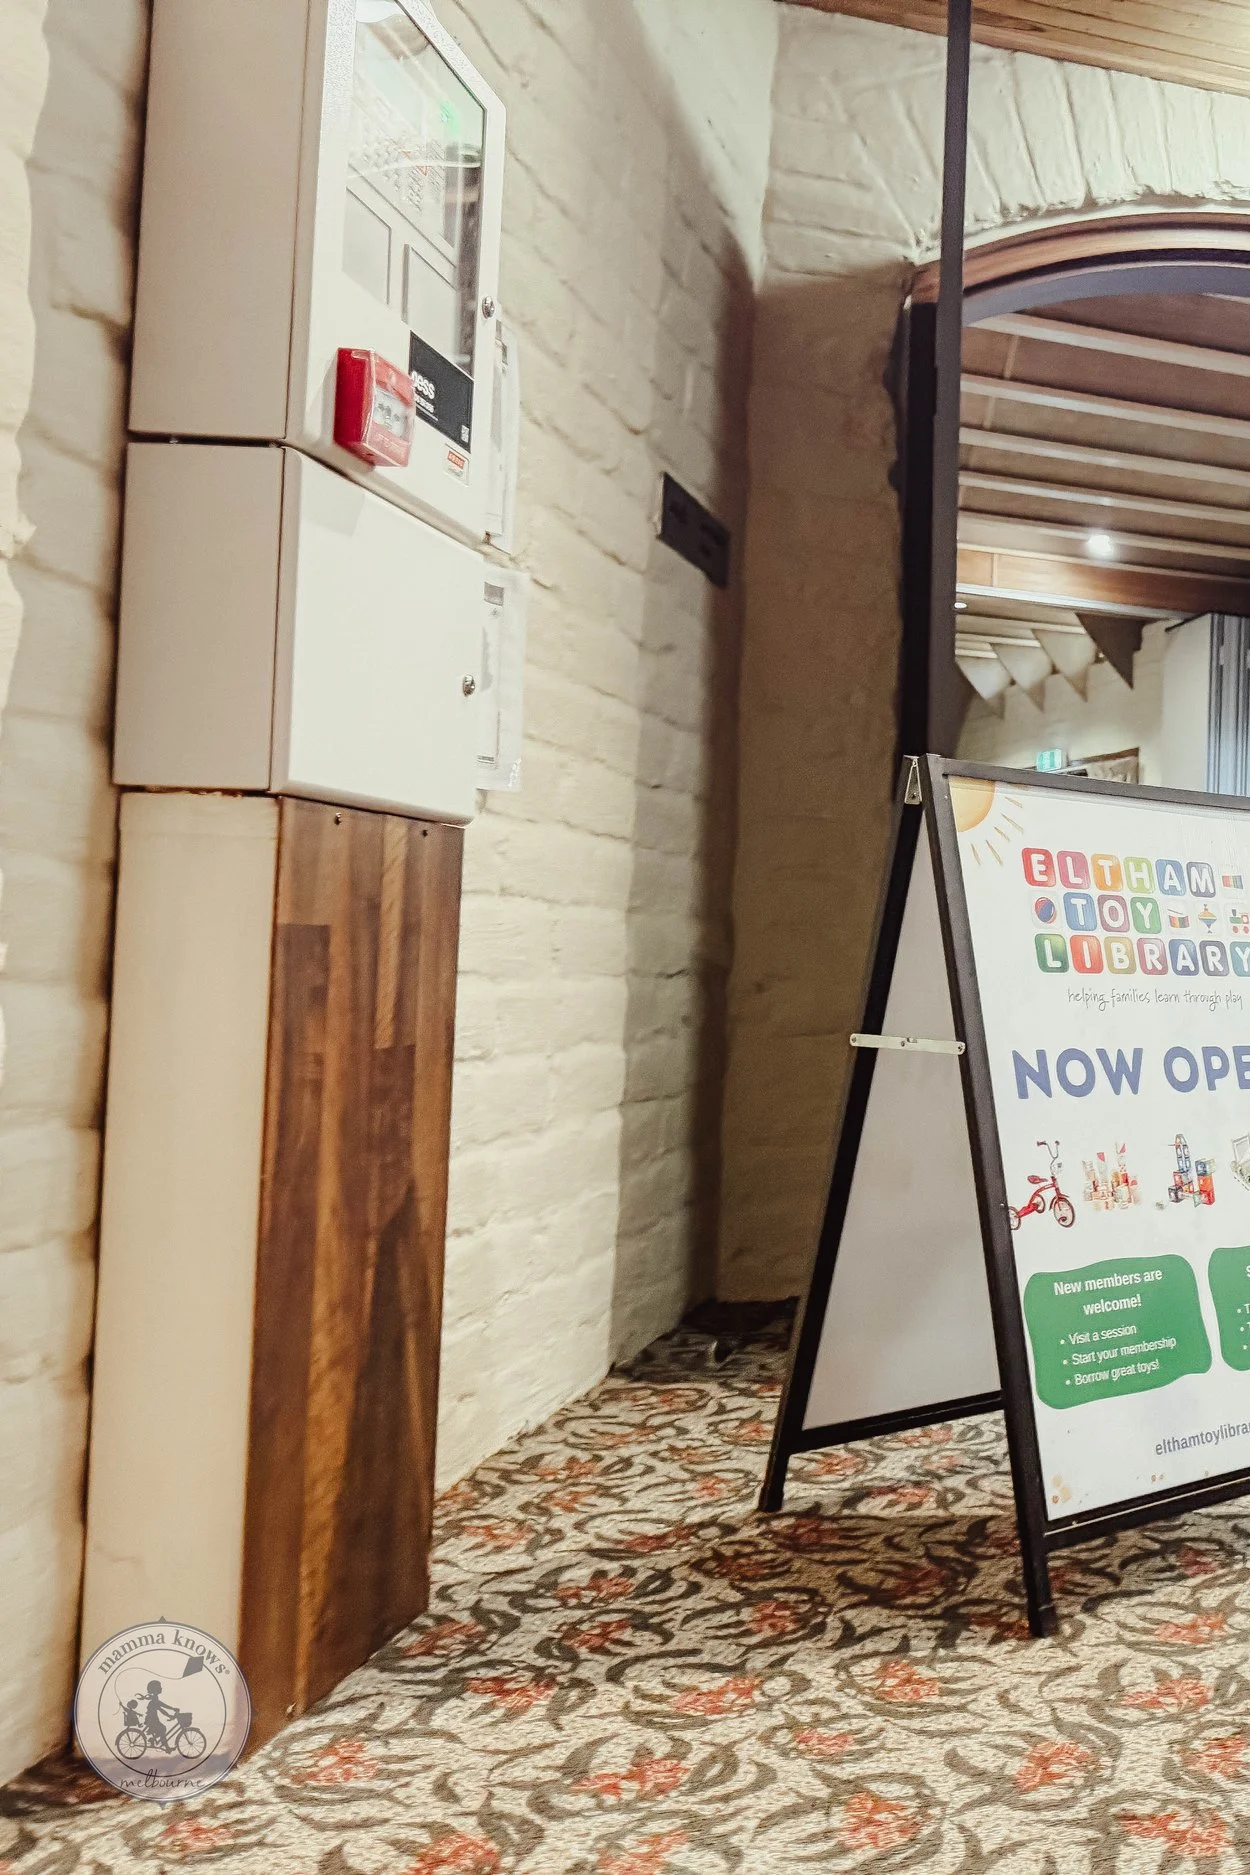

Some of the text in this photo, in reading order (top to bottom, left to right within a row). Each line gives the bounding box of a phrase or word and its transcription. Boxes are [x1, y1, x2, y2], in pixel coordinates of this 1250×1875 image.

[1022, 848, 1216, 897] ELTHAM
[1064, 892, 1162, 934] TOY
[1068, 988, 1243, 1011] helping families learn through play
[1012, 1047, 1143, 1100] NOW
[1054, 1269, 1162, 1296] New members are
[1083, 1294, 1141, 1315] welcome!
[1069, 1325, 1137, 1345] Visit a session
[1072, 1337, 1176, 1365] Start your membership
[1075, 1359, 1159, 1386] Borrow great toys!
